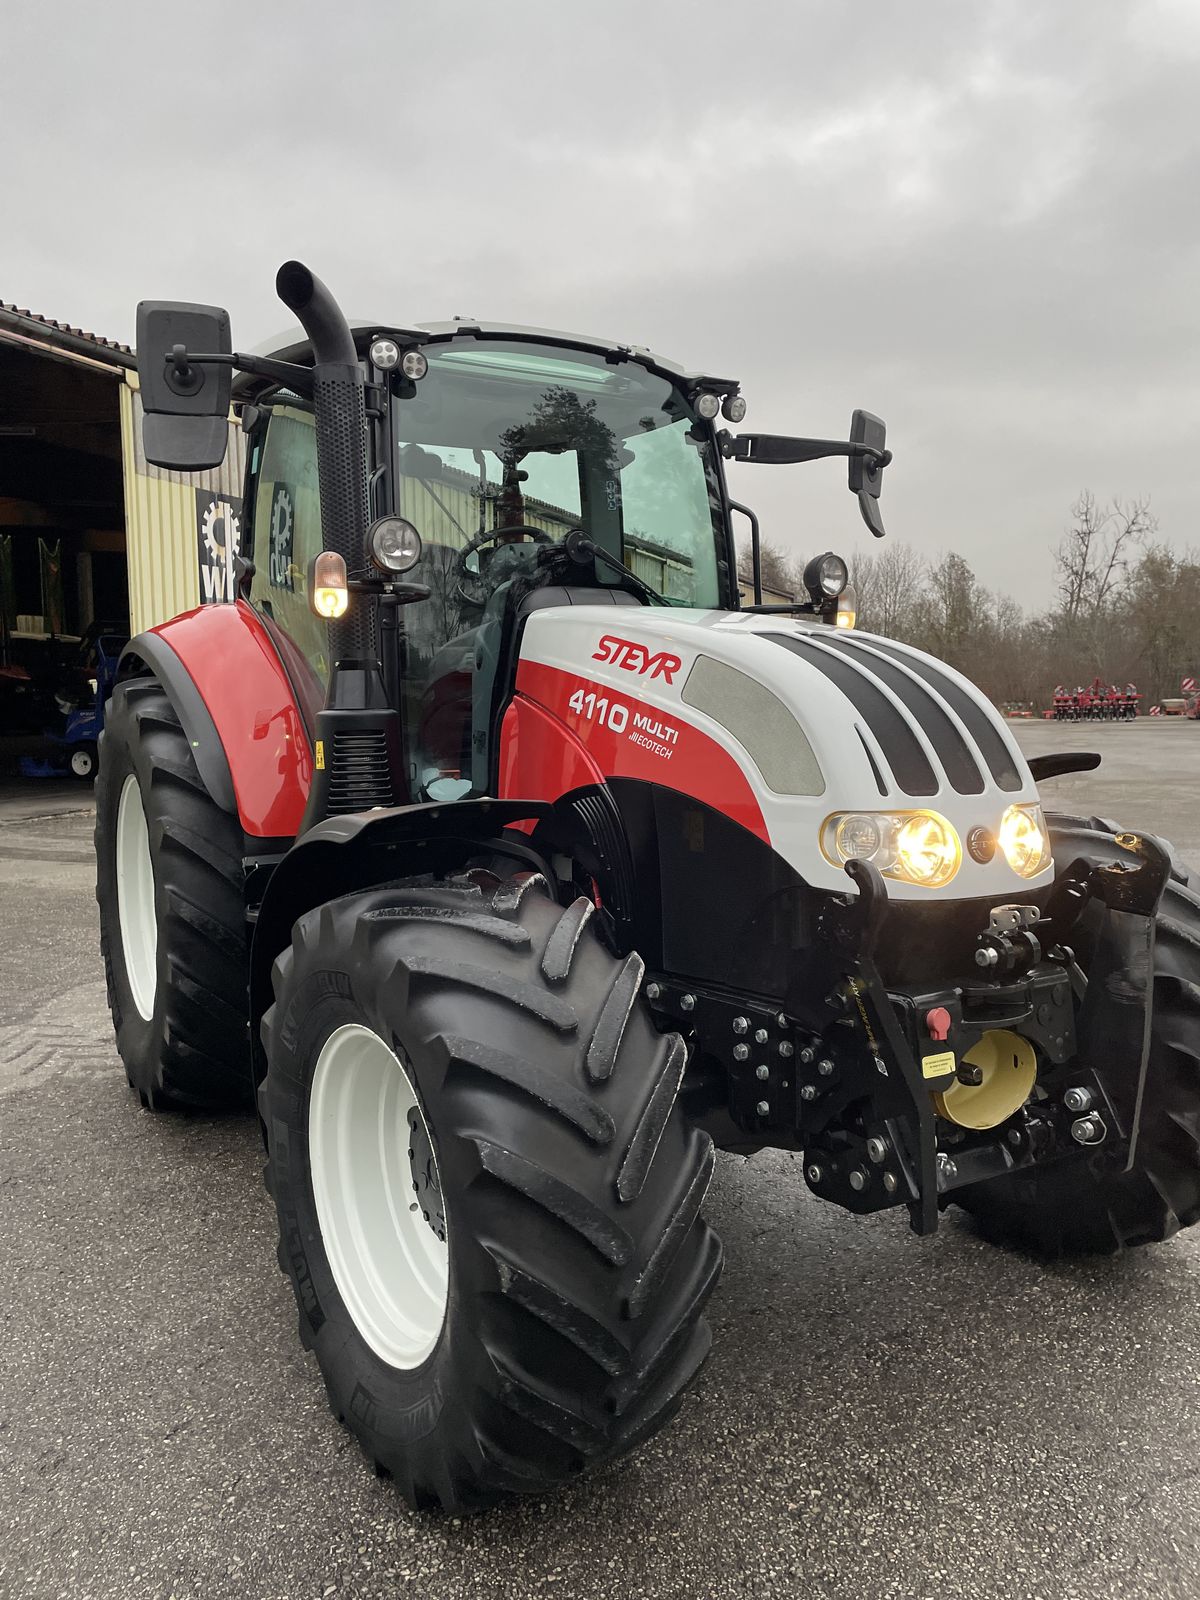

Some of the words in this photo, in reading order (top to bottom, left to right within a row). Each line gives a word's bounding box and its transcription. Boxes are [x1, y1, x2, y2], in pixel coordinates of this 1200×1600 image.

[591, 634, 682, 686] STEYR
[568, 689, 629, 734] 4110
[633, 712, 680, 745] MULTI
[635, 734, 673, 760] ECOTECH
[971, 840, 995, 850] STE
